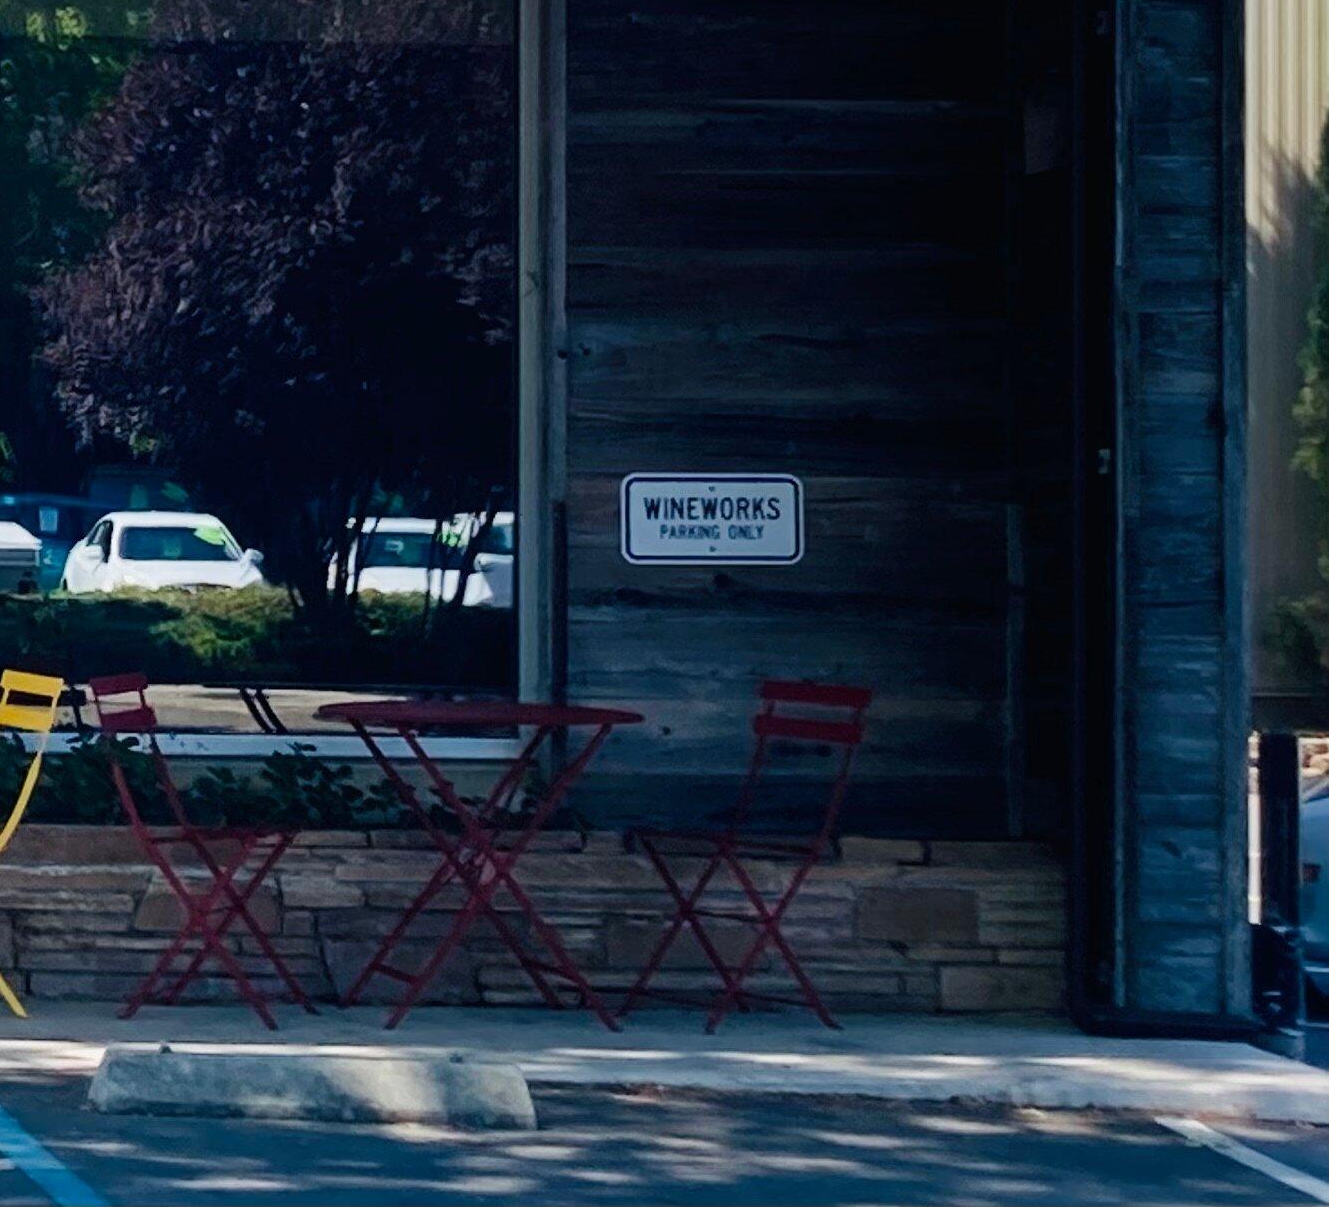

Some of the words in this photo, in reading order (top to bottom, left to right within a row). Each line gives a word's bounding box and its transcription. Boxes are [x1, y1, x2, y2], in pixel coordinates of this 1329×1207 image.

[644, 497, 781, 520] WINEWORKS
[659, 524, 721, 540] PARKING
[728, 524, 765, 540] ONLY
